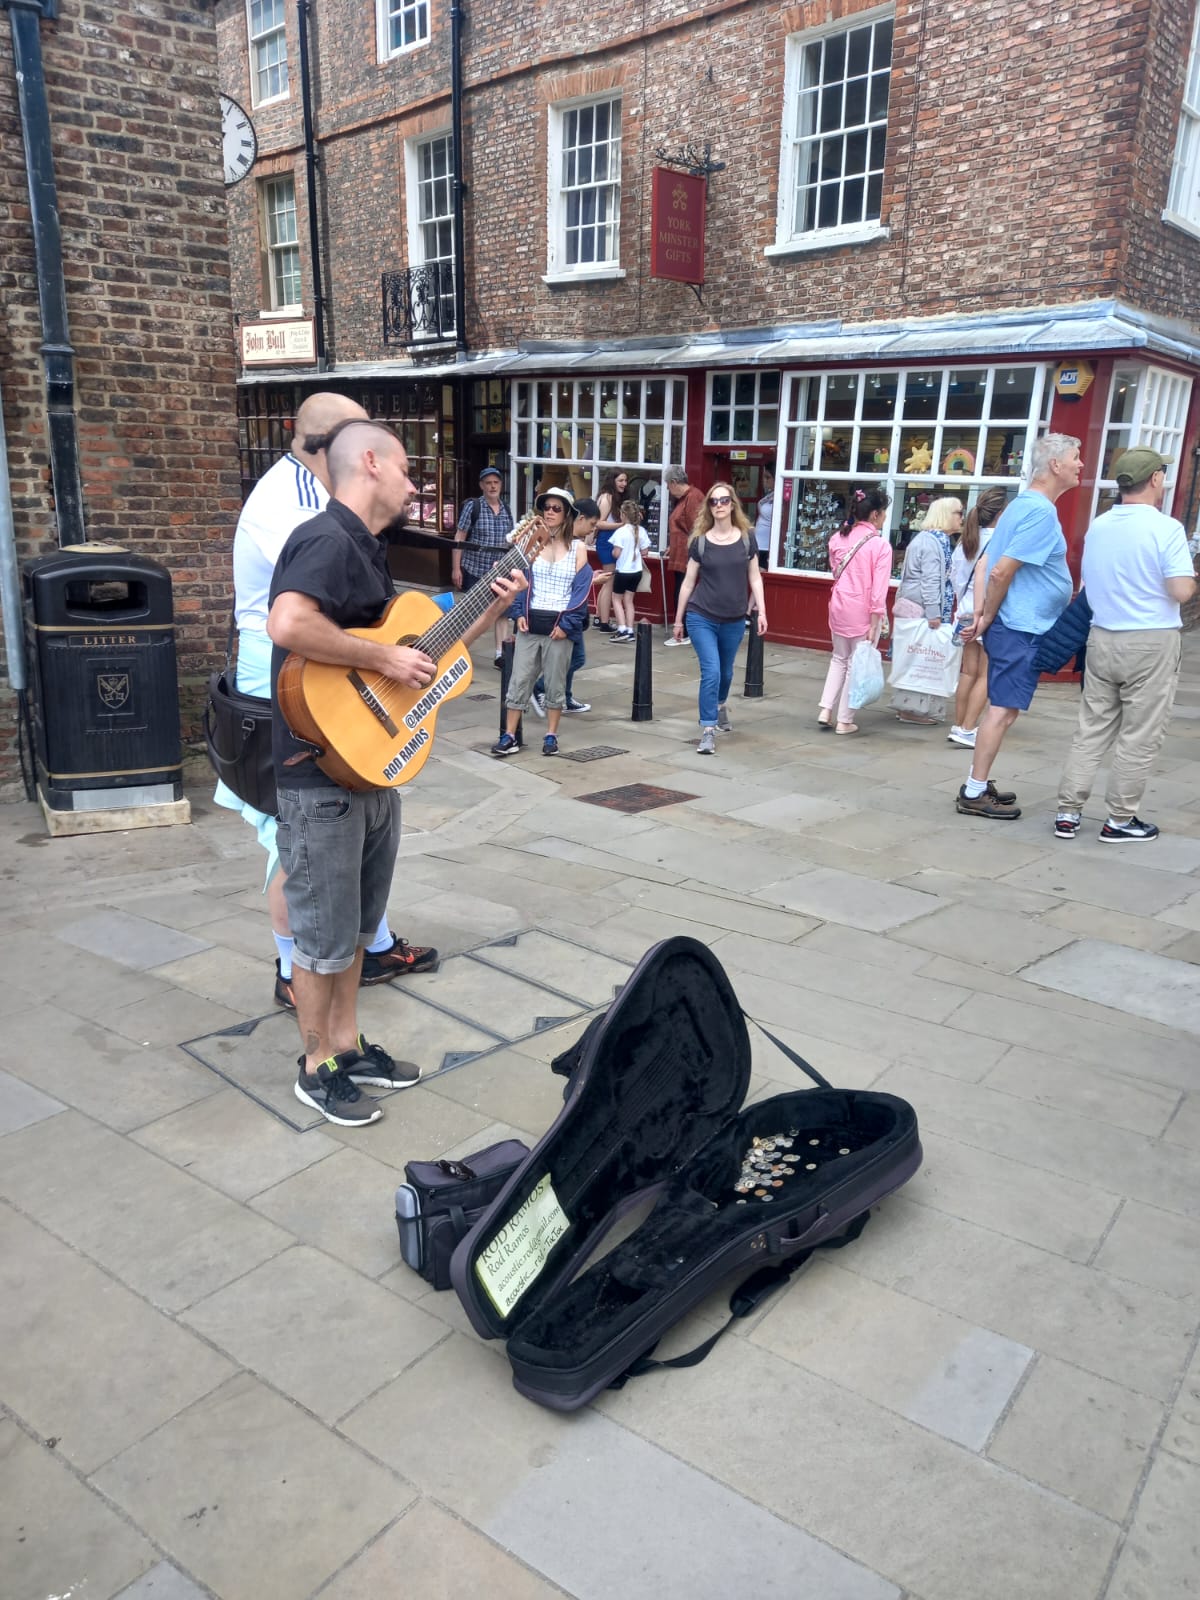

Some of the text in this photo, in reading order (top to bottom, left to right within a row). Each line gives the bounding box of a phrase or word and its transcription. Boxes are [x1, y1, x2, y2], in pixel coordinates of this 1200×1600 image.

[659, 231, 699, 249] MINSTER
[668, 216, 691, 232] YORK
[665, 248, 692, 264] GIFTS
[84, 635, 137, 645] LITTER
[405, 658, 469, 729] @ACOUSTIC.ROD
[383, 728, 429, 780] ROD RAMOS
[481, 1231, 508, 1263] ROD
[487, 1225, 530, 1276] Rod Ramos
[498, 1207, 561, 1292] acoustic.rod@gmail.com
